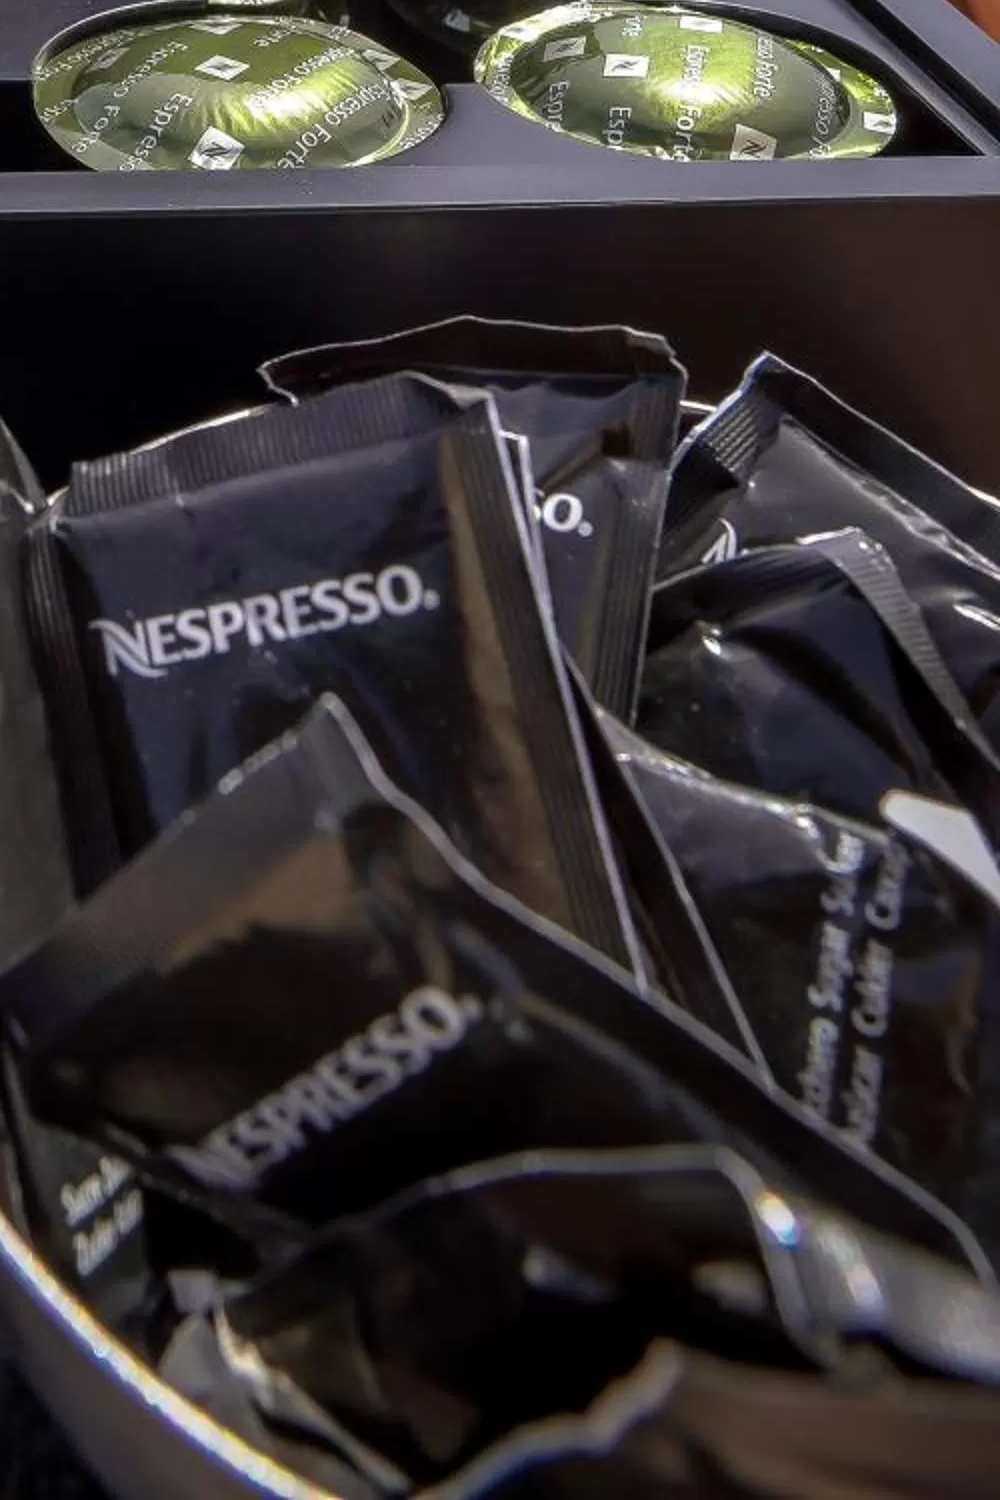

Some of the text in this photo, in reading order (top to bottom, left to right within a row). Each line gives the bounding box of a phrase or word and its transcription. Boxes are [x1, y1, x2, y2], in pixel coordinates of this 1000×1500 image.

[119, 92, 193, 173] Espresso
[275, 122, 334, 170] Forte
[88, 565, 425, 677] NESPRESSO
[170, 986, 467, 1190] NESPRESSO
